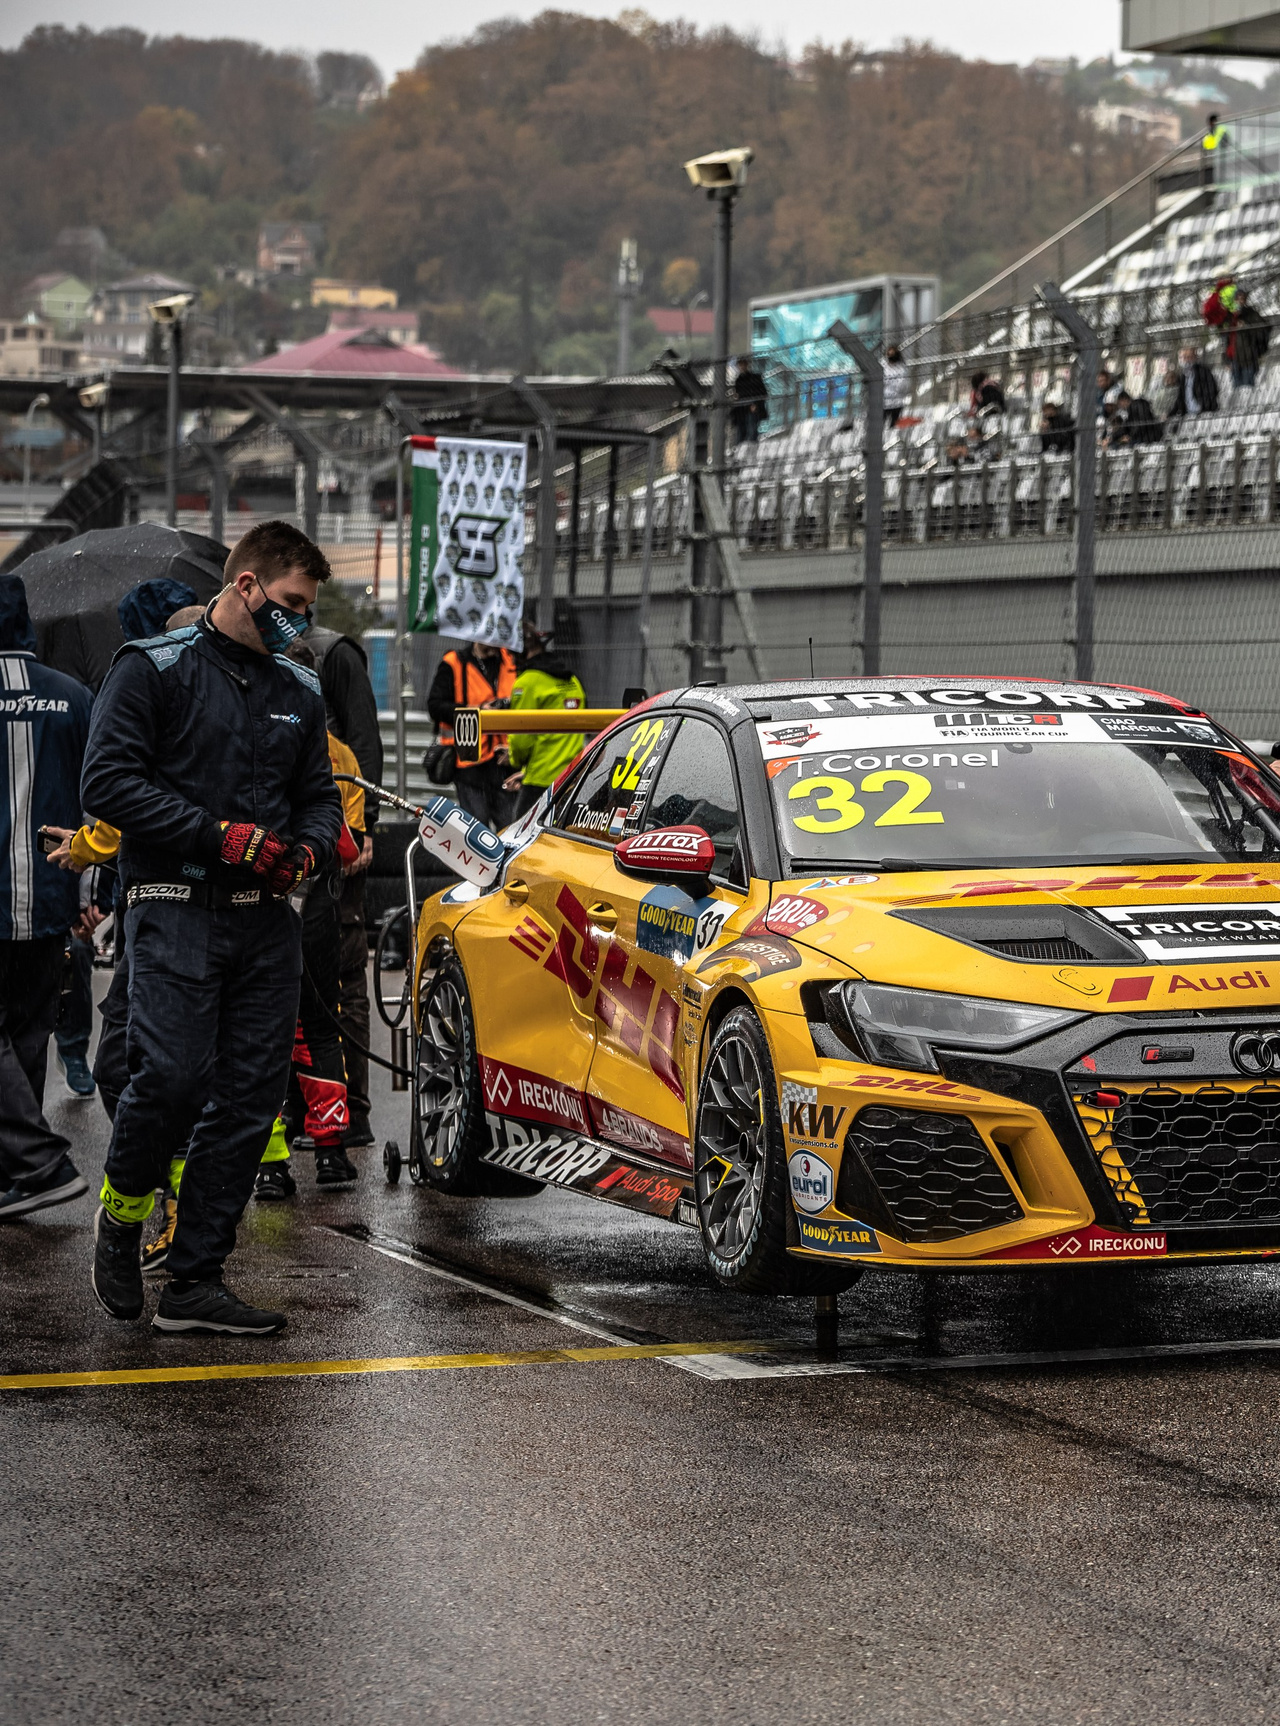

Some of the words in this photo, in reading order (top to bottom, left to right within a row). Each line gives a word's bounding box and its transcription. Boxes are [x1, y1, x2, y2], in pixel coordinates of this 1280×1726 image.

[790, 689, 1146, 713] TRICORP
[1100, 717, 1136, 726] CIAO
[1105, 724, 1177, 734] MARCELA
[611, 719, 664, 791] 32
[787, 749, 999, 778] T.Coronel
[788, 769, 945, 834] 32
[572, 803, 615, 832] T.Coronel
[244, 828, 265, 861] PIT-TECH
[628, 832, 711, 850] inTrax
[181, 865, 206, 879] OMP
[951, 872, 1280, 898] DHL
[640, 903, 695, 936] GOODYEAR
[1179, 933, 1279, 943] WORKWEAR
[726, 941, 791, 966] PRESTIGE
[543, 884, 686, 1104] DHL
[1168, 969, 1270, 994] Audi
[848, 1074, 961, 1098] DHL
[518, 1079, 584, 1125] IRECKONU
[789, 1101, 849, 1139] KW
[484, 1112, 611, 1185] TRICORP
[617, 1170, 658, 1194] Audi
[647, 1178, 682, 1203] Spo
[792, 1175, 828, 1195] eurol
[803, 1222, 871, 1246] GOODYEAR
[1089, 1237, 1165, 1252] IRECKONU
